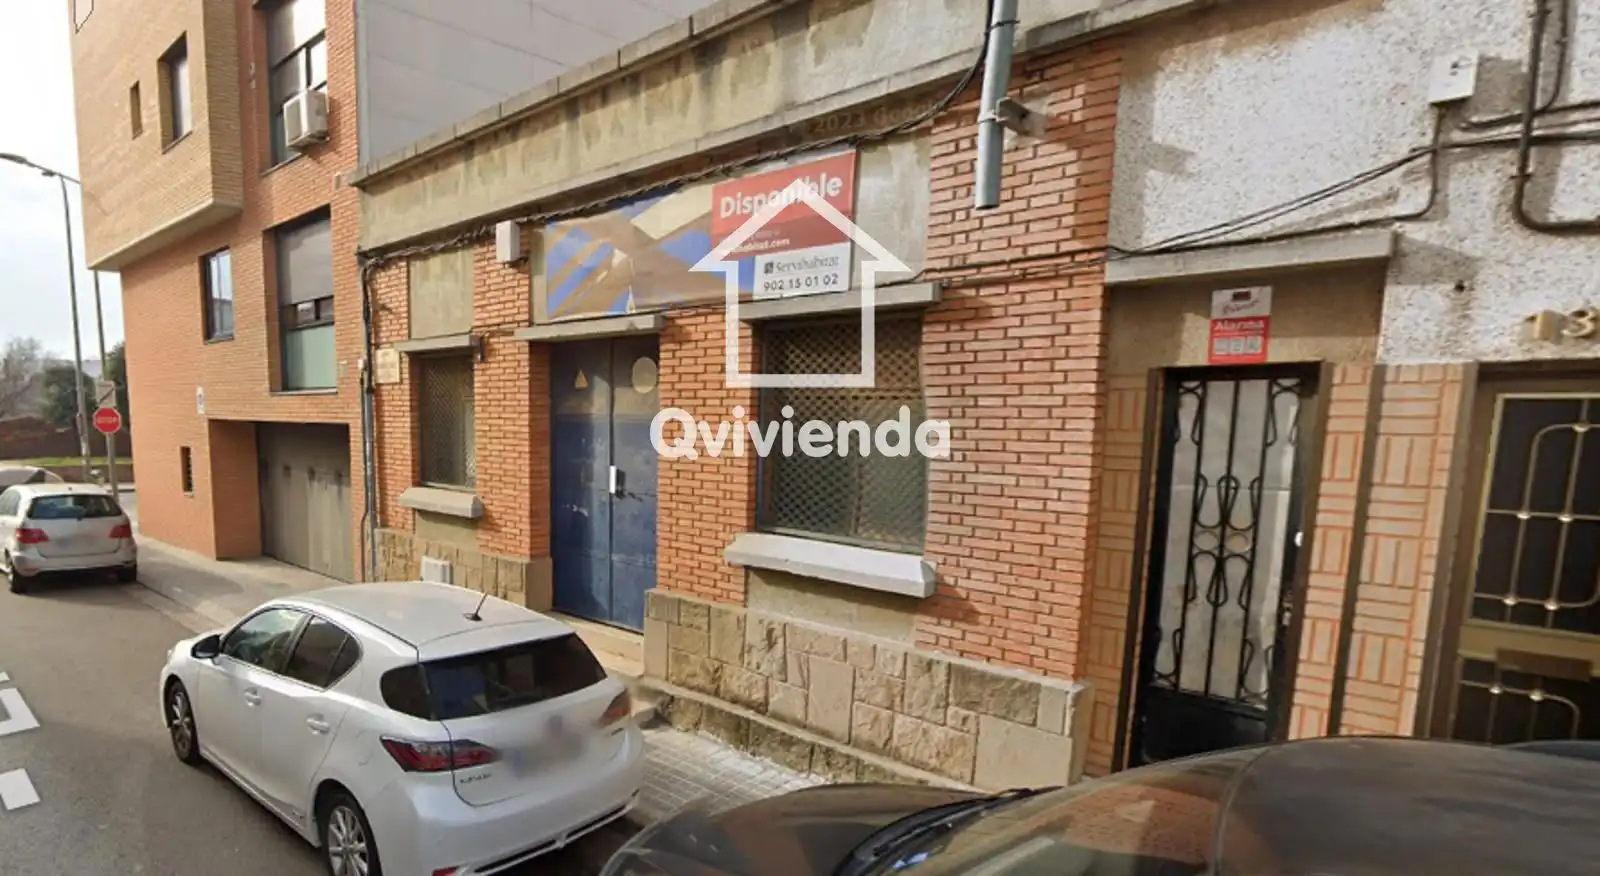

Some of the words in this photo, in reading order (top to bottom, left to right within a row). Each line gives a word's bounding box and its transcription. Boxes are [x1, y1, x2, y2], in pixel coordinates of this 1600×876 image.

[719, 172, 844, 219] Disponible
[763, 280, 785, 292] 902
[789, 278, 801, 289] 15
[804, 275, 819, 288] 01
[822, 273, 839, 286] 02
